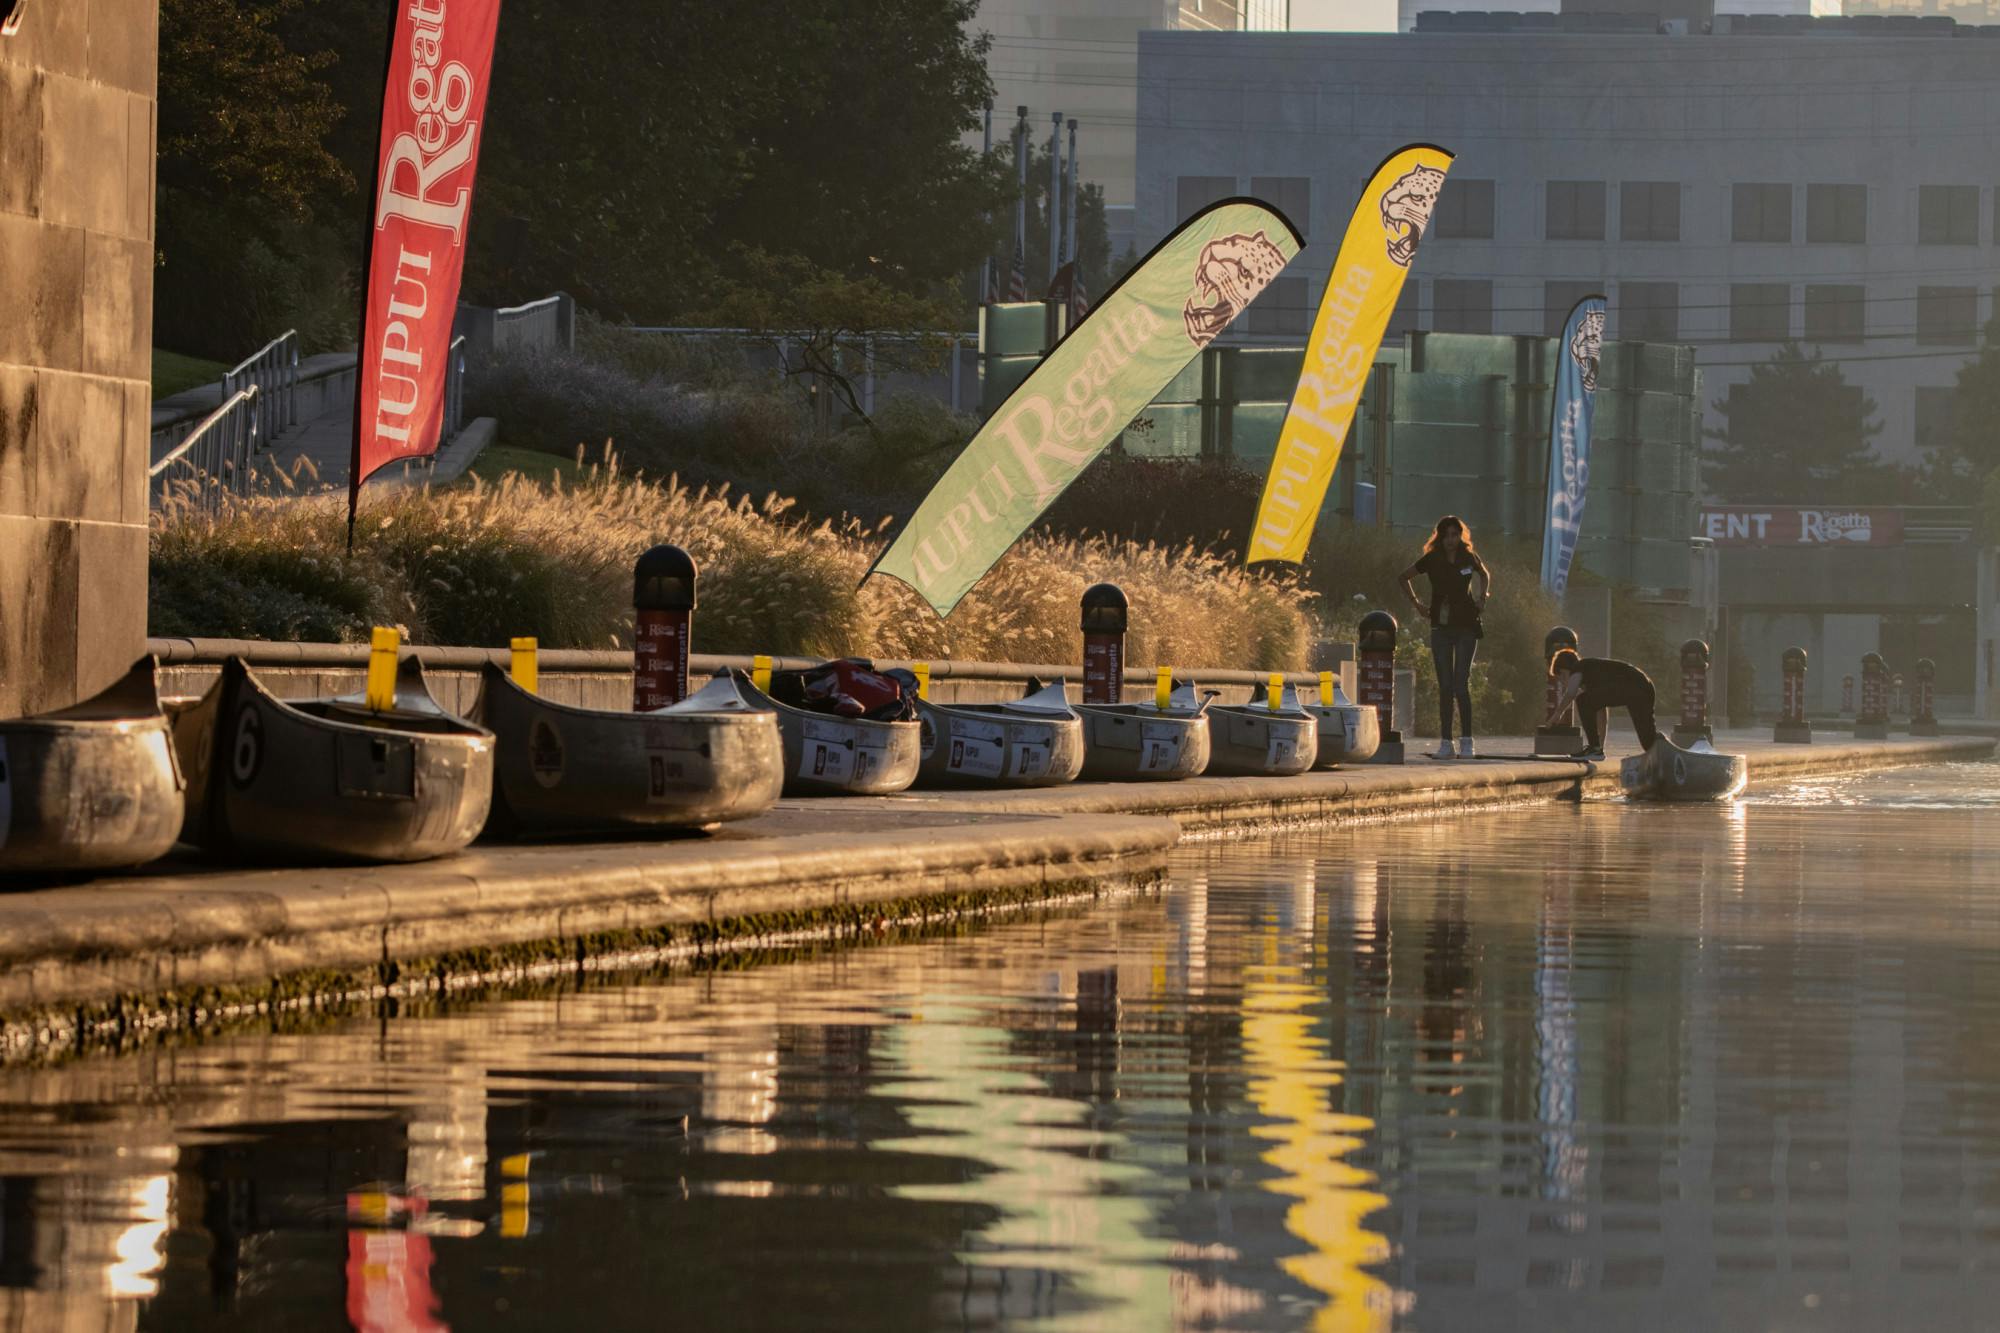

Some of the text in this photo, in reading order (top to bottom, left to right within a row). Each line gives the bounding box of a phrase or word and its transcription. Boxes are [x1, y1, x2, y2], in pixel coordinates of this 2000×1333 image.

[375, 243, 432, 449] IUPUI
[911, 303, 1165, 591] IUPUI Regatta
[1257, 263, 1374, 553] IUPUI Regatta
[1797, 510, 1872, 543] Regatta
[234, 706, 258, 780] 6
